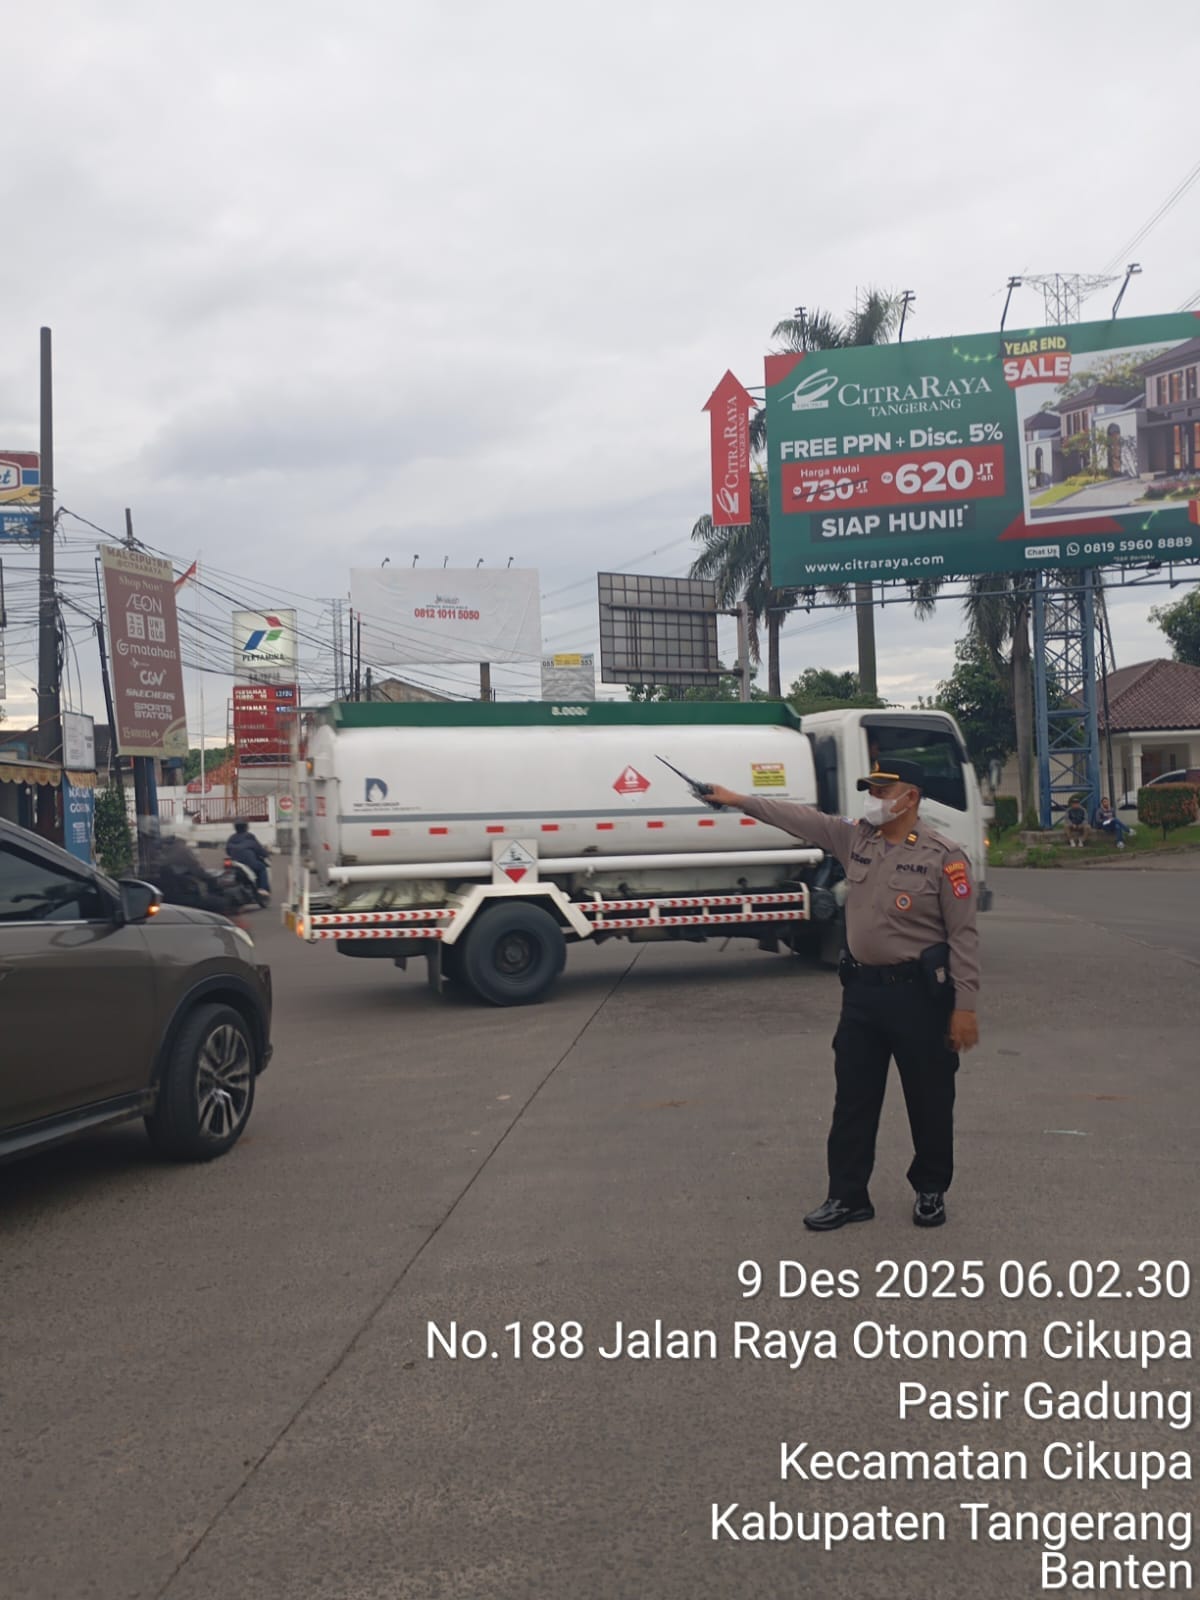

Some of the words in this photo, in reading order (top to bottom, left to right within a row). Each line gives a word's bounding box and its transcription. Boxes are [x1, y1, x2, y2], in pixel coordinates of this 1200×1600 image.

[1004, 340, 1038, 355] YEAR
[1040, 336, 1067, 351] END
[1003, 356, 1070, 382] SALE
[868, 398, 961, 417] TANGERANG
[780, 437, 837, 460] FREE
[843, 432, 891, 454] PPN
[896, 437, 905, 447] +
[909, 427, 963, 448] Disc.
[969, 423, 1003, 442] 5%
[800, 468, 830, 478] Harga
[832, 464, 860, 475] Mulai
[895, 459, 974, 494] 620
[976, 463, 994, 476] JT
[802, 477, 854, 503] 730
[821, 515, 880, 537] SIAP
[1084, 542, 1115, 554] 0819
[1120, 539, 1153, 551] 5960
[1157, 537, 1193, 549] 8889
[805, 555, 944, 573] www.citraraya.com
[414, 607, 435, 618] 0812
[130, 644, 177, 660] matahari
[140, 670, 163, 686] CGV
[134, 702, 171, 712] SPORTS
[896, 863, 928, 875] POLRI
